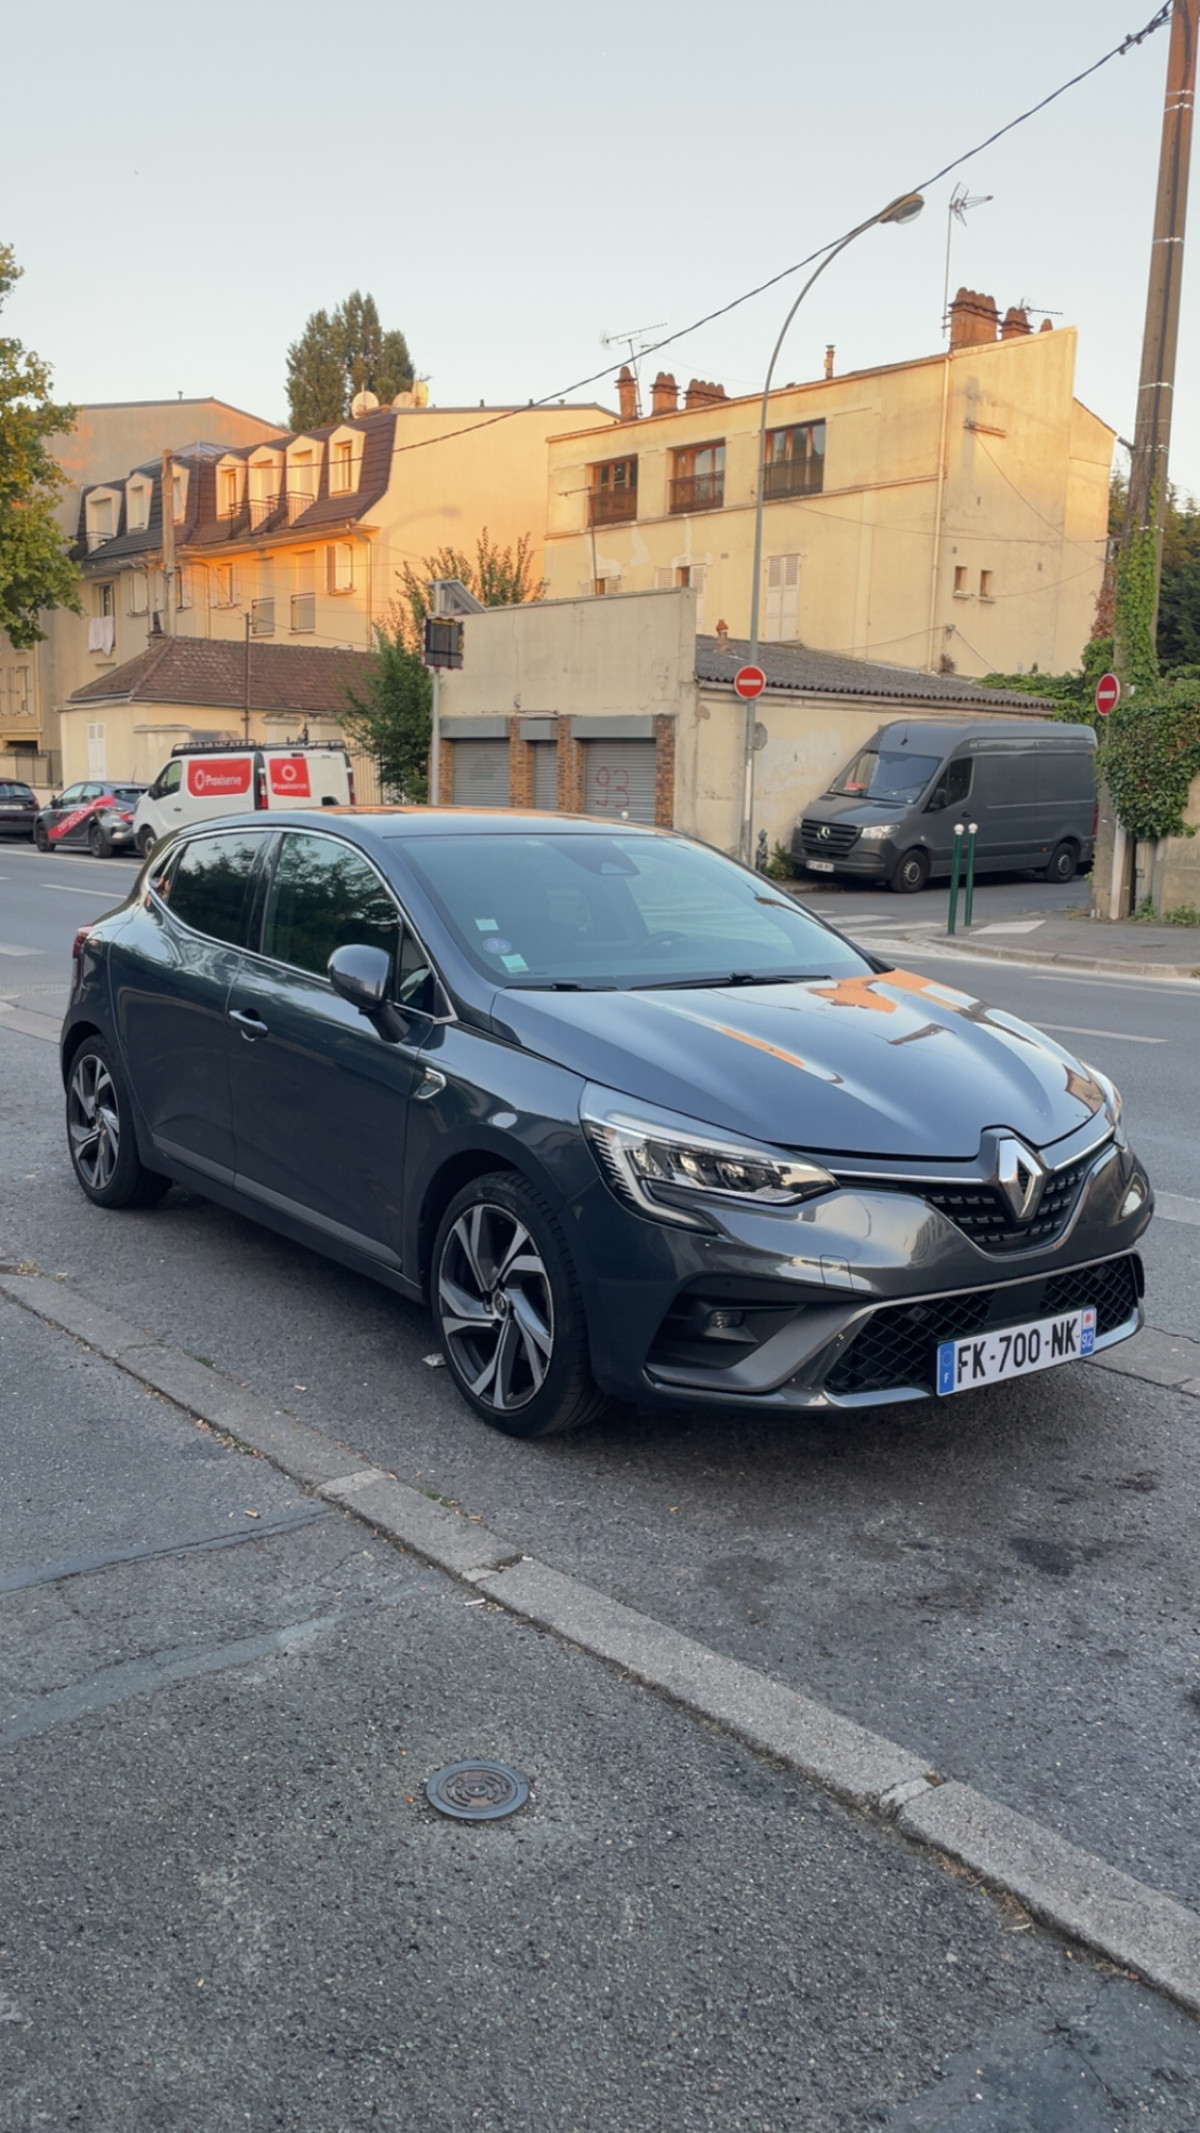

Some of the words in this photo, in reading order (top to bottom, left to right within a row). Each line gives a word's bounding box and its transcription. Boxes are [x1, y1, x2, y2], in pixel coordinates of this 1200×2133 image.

[1081, 1332, 1094, 1348] 92
[957, 1318, 1078, 1384] FK-700-NK
[944, 1372, 949, 1384] F
